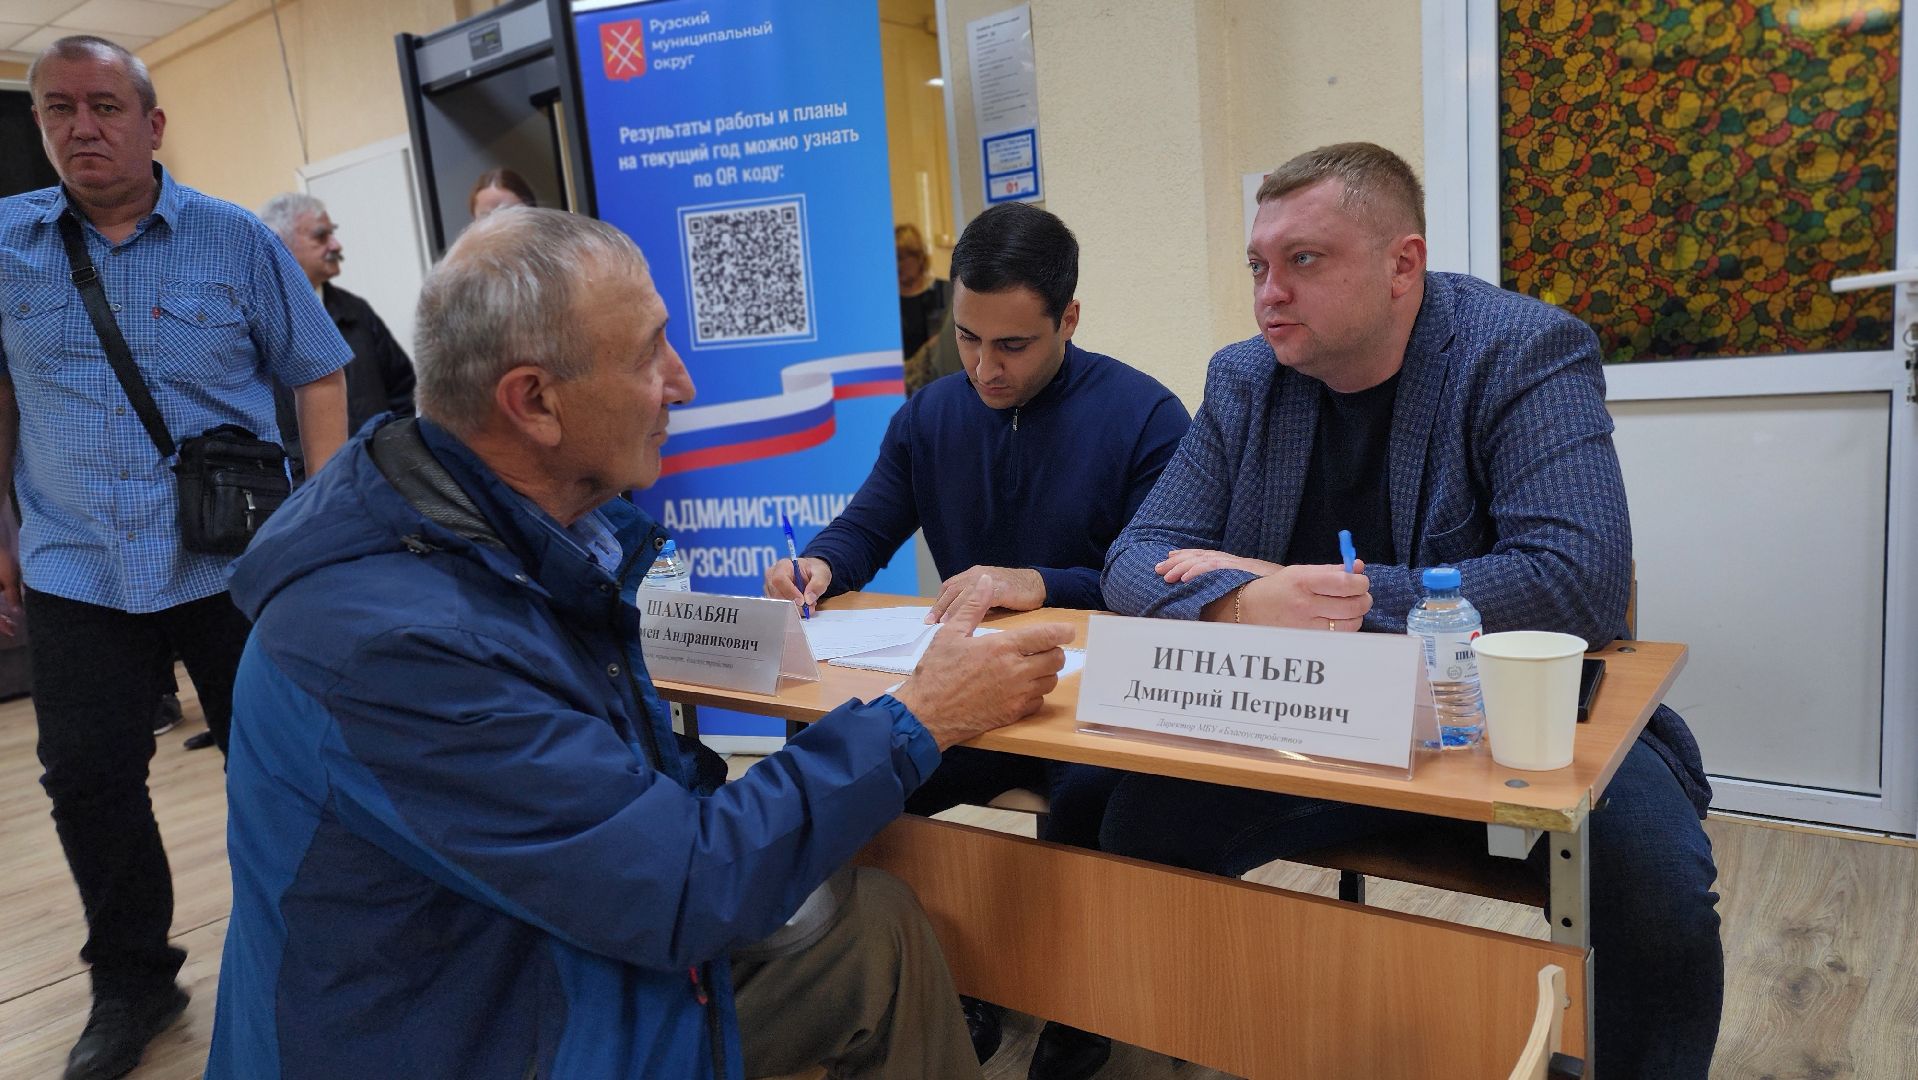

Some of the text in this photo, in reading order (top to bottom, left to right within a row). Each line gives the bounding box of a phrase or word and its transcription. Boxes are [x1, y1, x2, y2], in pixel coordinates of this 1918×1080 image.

[650, 11, 710, 33] Рузский
[652, 21, 773, 51] муниципальный
[653, 54, 694, 71] округ
[619, 101, 848, 145] Результаты работы и планы
[618, 128, 860, 171] на текущий год можно узнать
[693, 164, 784, 188] по QR коду:
[663, 493, 856, 532] АДМИНИСТРАЦИ
[674, 546, 778, 577] УЗСКОГО
[647, 600, 739, 624] ШАХБАБЯН
[639, 627, 759, 651] мен Андраникович
[1153, 646, 1326, 685] ИГНАТЬЕВ
[1123, 679, 1350, 724] Дмитрий Петрович
[1156, 718, 1196, 731] Директор
